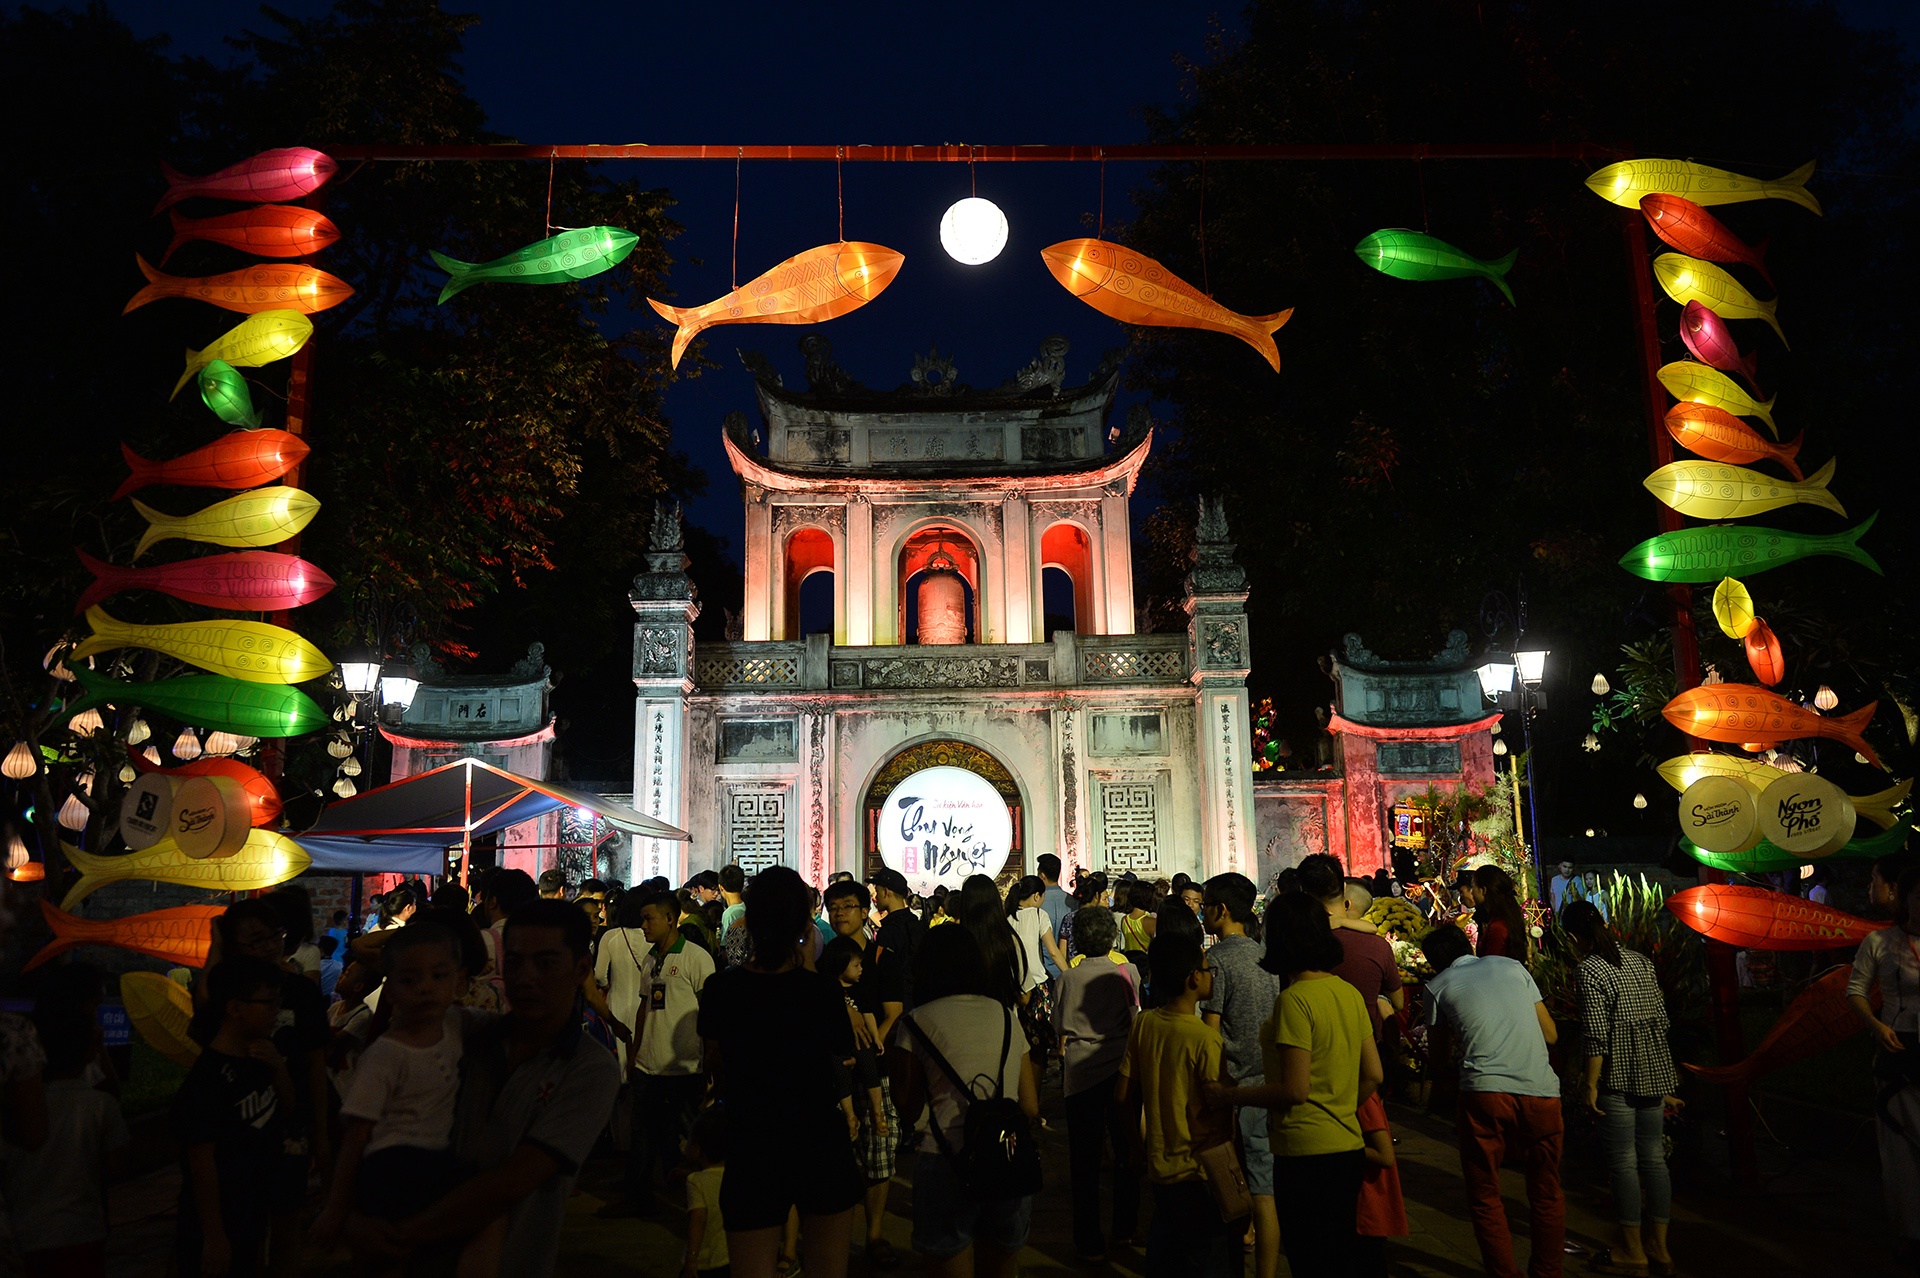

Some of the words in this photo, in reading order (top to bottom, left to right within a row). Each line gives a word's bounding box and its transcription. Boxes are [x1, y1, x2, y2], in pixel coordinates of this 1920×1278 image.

[898, 796, 937, 842] Thu
[1692, 804, 1714, 827] Sài
[1714, 805, 1740, 818] Thành
[1778, 793, 1822, 819] Ngon
[942, 815, 974, 843] Vọng
[1780, 811, 1821, 838] Phố
